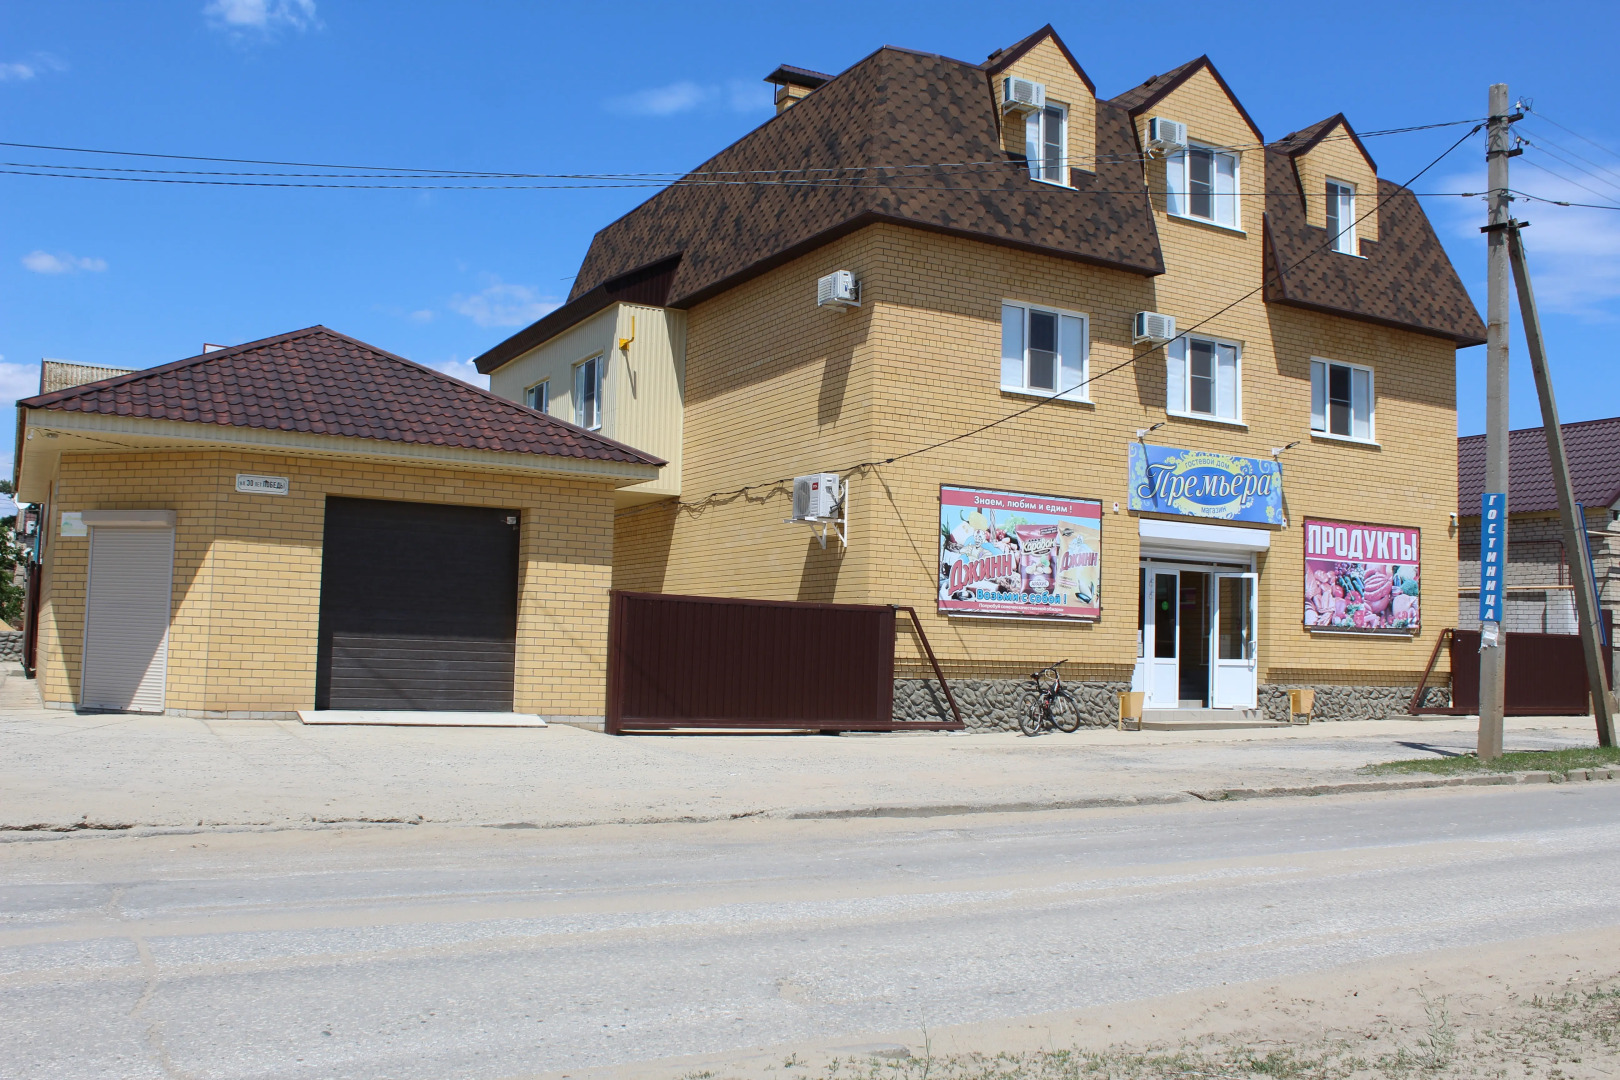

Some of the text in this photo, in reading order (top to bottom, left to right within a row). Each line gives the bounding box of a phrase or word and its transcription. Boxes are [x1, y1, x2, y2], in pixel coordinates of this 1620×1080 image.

[974, 495, 1005, 507] Знаем,
[1007, 498, 1037, 509] любим
[1137, 463, 1272, 506] Премьера
[1308, 524, 1417, 561] ПРОДУКТЫ
[1484, 495, 1498, 620] ГОСТИНИЦА
[976, 588, 1019, 601] Возьми
[1021, 593, 1028, 602] с
